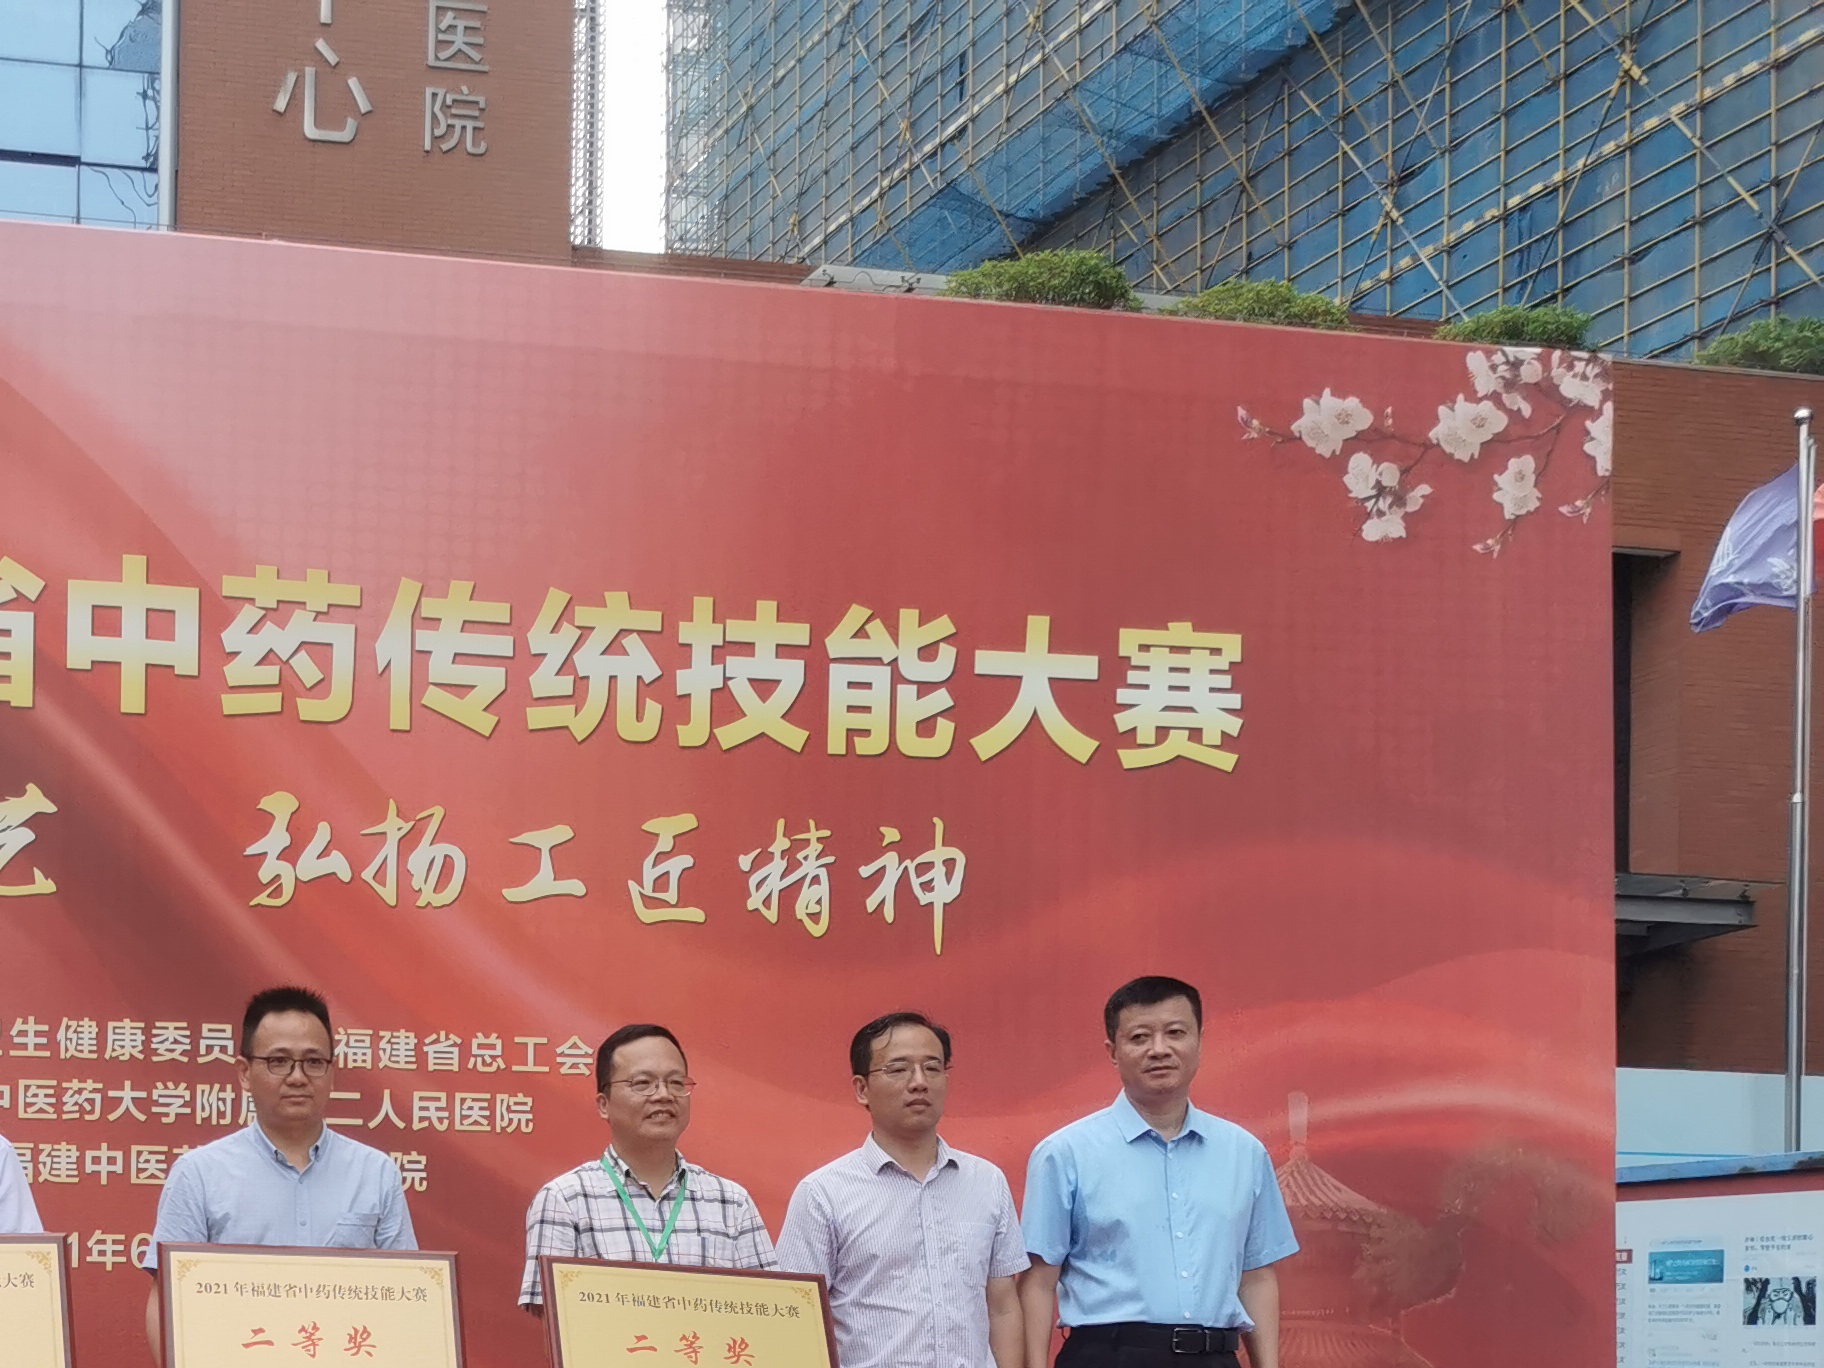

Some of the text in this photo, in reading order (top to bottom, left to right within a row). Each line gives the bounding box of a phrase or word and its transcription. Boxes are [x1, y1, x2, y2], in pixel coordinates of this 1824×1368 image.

[423, 0, 489, 156] 医院
[242, 790, 967, 956] 弘扬工匠精神
[334, 1026, 595, 1077] 福建省总工会
[195, 1281, 428, 1303] 2021年福建省中药传统技能大赛
[578, 1291, 801, 1319] 2021年福建省中药传统技能大赛
[241, 1320, 378, 1359] 二等奖
[626, 1330, 756, 1367] 二等奖
